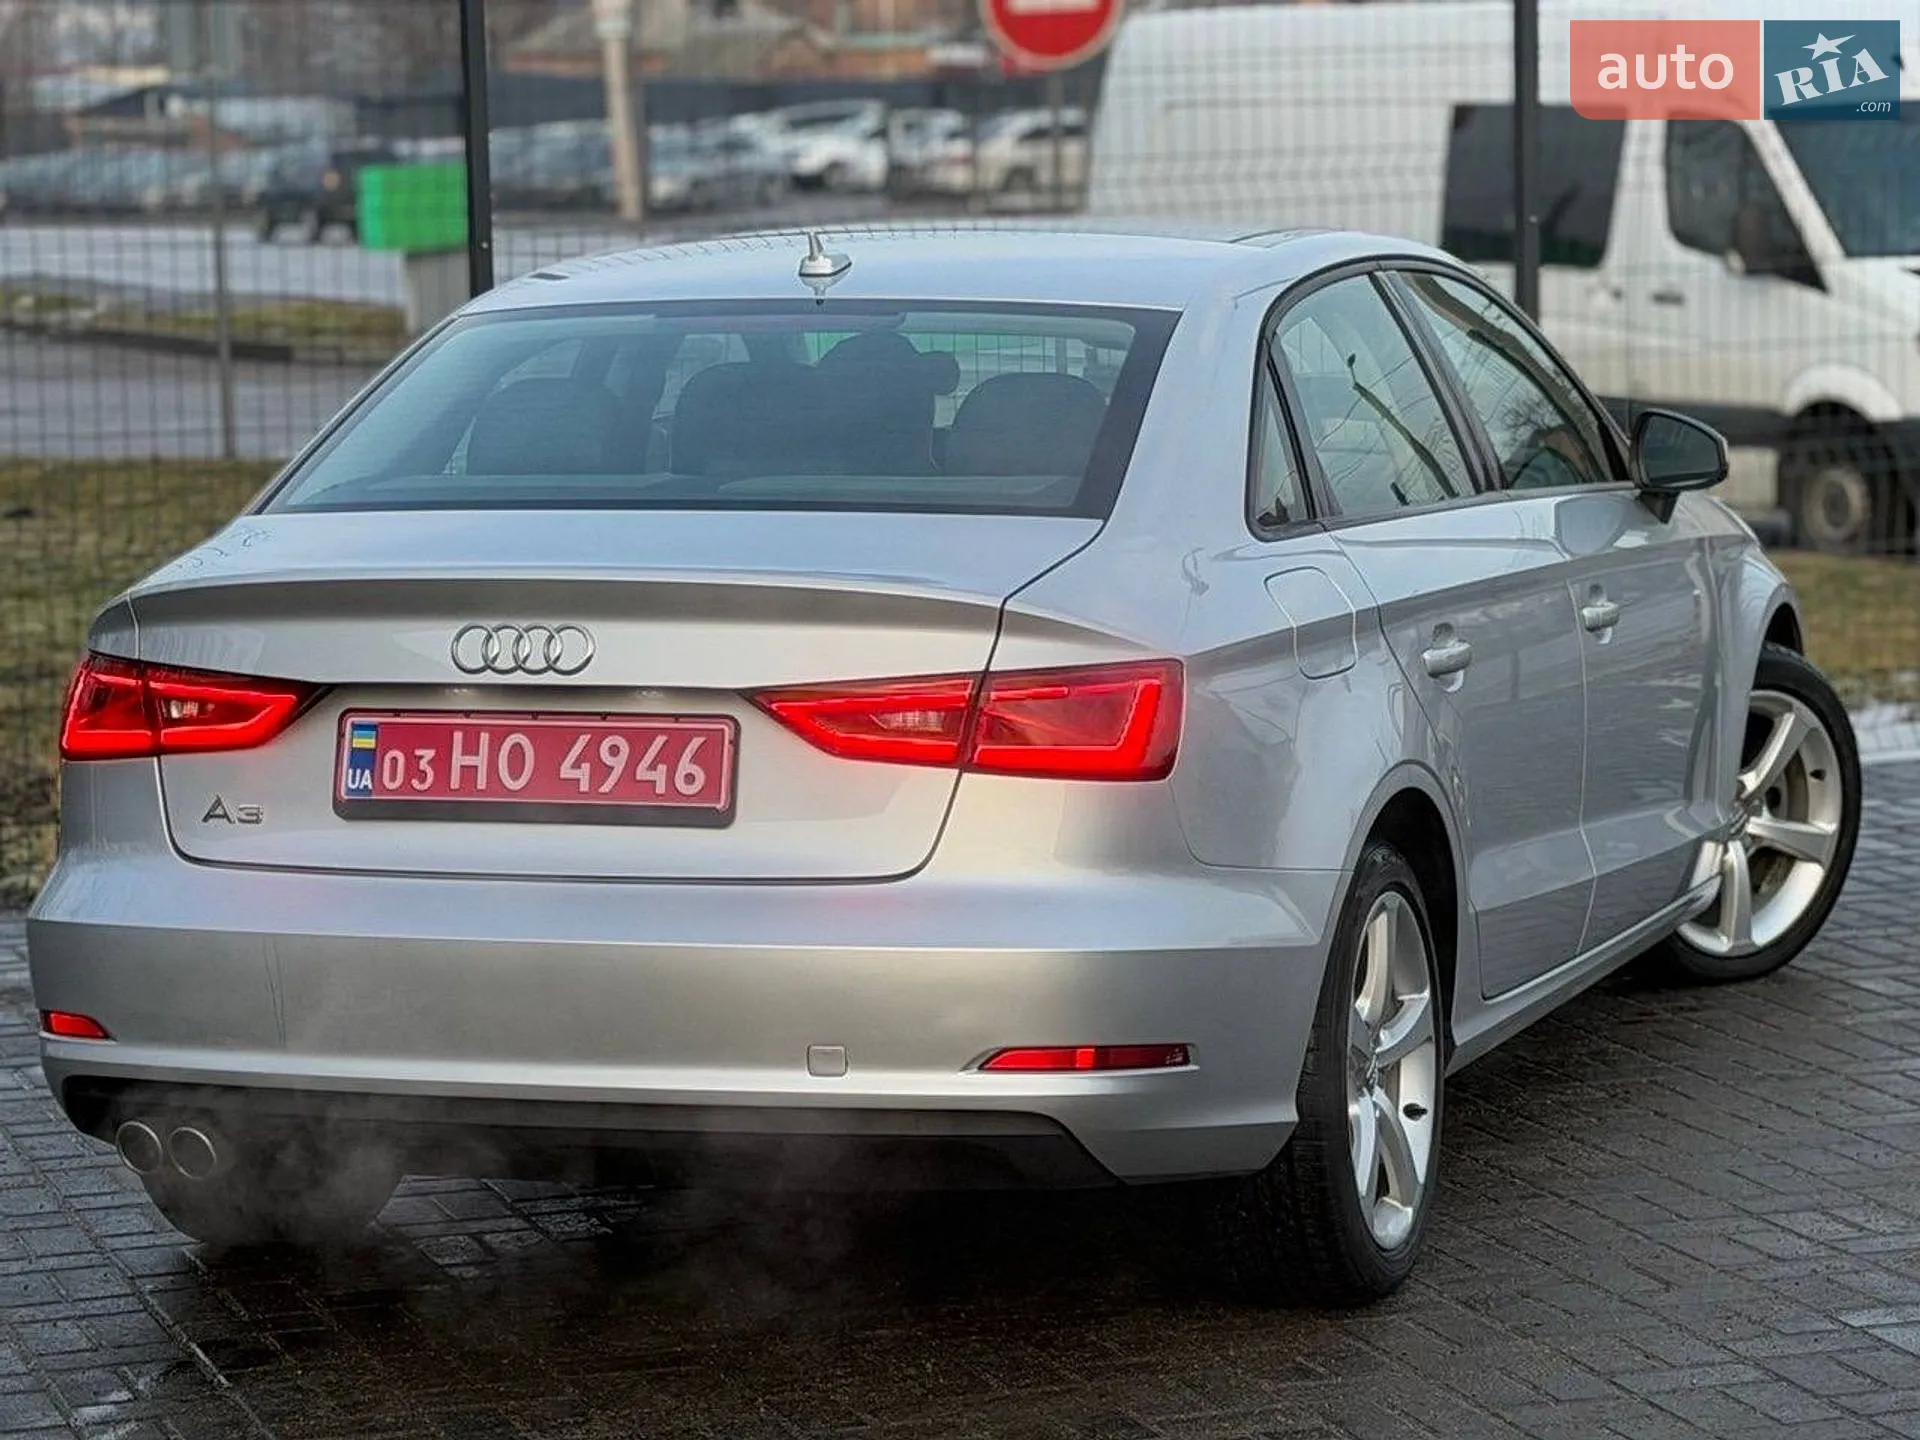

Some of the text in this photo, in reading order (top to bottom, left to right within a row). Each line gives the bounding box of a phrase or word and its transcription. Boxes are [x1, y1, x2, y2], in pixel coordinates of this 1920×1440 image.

[382, 730, 708, 796] 03 HO 4946
[347, 768, 374, 791] UA
[201, 794, 263, 824] A3
